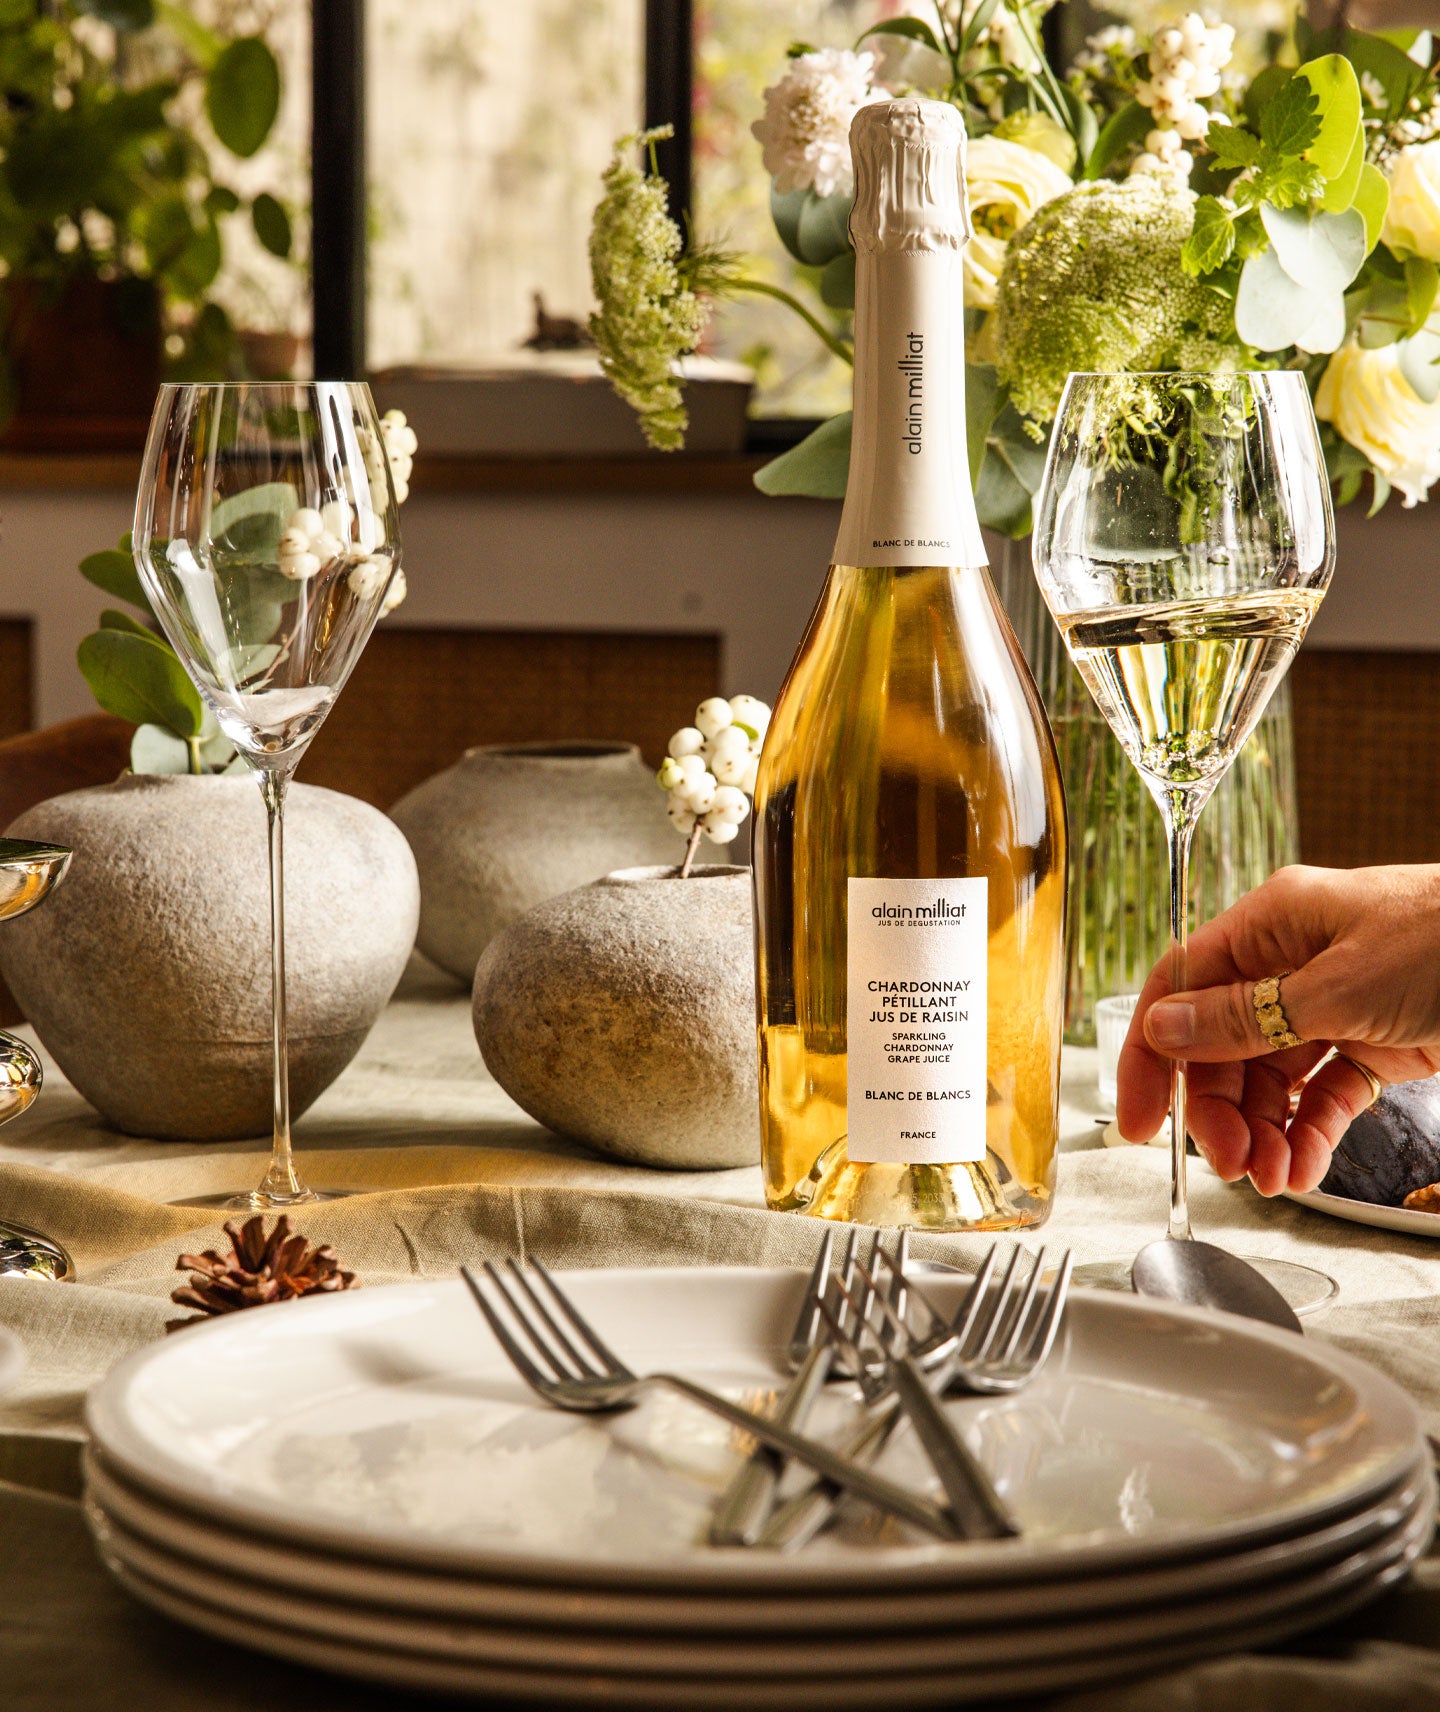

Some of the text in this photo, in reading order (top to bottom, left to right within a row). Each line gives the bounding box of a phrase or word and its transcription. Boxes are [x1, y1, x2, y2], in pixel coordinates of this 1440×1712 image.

[897, 331, 924, 455] alain milliat
[872, 539, 951, 549] BLANC DE BLANCS
[872, 897, 967, 919] alain milliat
[877, 919, 961, 927] JUS DE DEGUSTATION
[867, 980, 971, 993] CHARDONNAY
[882, 994, 957, 1008] PÉTILLANT
[869, 1010, 969, 1023] JUS DE RAISIN
[891, 1031, 947, 1041] SPARKLING
[883, 1043, 955, 1053] CHARDONNAY
[887, 1054, 951, 1064] GRAPE JUICE
[865, 1089, 971, 1101] BLANC DE BLANCS
[900, 1130, 937, 1140] FRANCE
